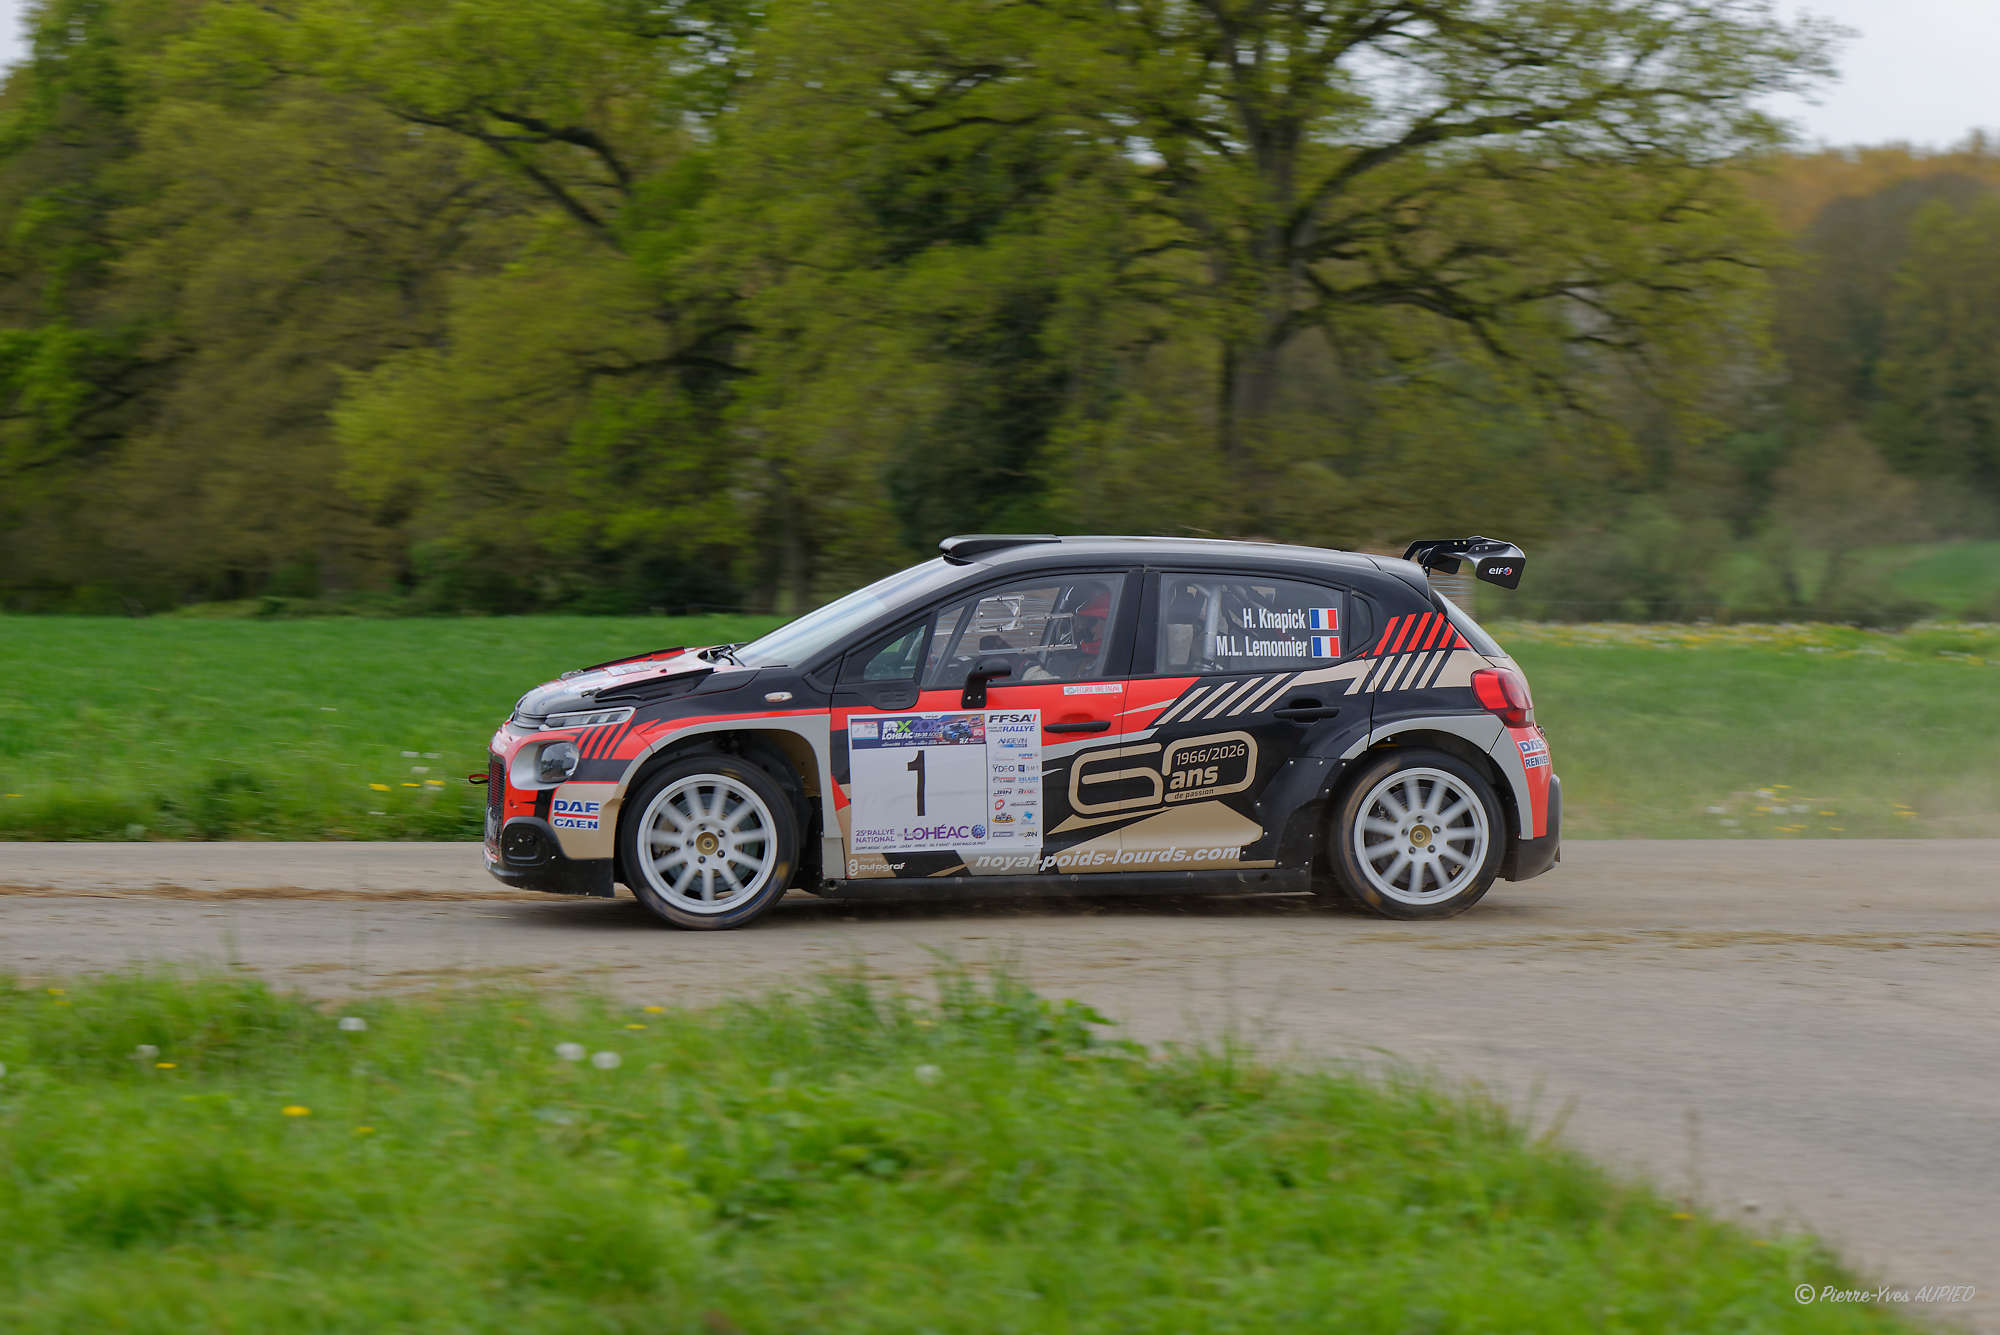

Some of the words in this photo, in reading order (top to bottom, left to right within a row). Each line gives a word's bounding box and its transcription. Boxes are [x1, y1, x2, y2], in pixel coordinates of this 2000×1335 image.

[1242, 608, 1256, 629] H.
[1258, 608, 1306, 634] Knapick
[1216, 635, 1243, 657] M.L.
[1245, 636, 1308, 657] Lemonnier
[989, 714, 1031, 723] FFSA
[1175, 743, 1245, 765] 1966/2026
[907, 750, 926, 816] 1
[1169, 765, 1219, 790] ans
[1174, 792, 1184, 800] de
[1185, 788, 1214, 799] passion
[553, 800, 600, 812] DAF
[553, 818, 599, 829] CAEN
[904, 824, 969, 841] LOHÉAC
[855, 836, 895, 844] NATIONAL
[975, 846, 1241, 872] noyal-poids-lourds.com
